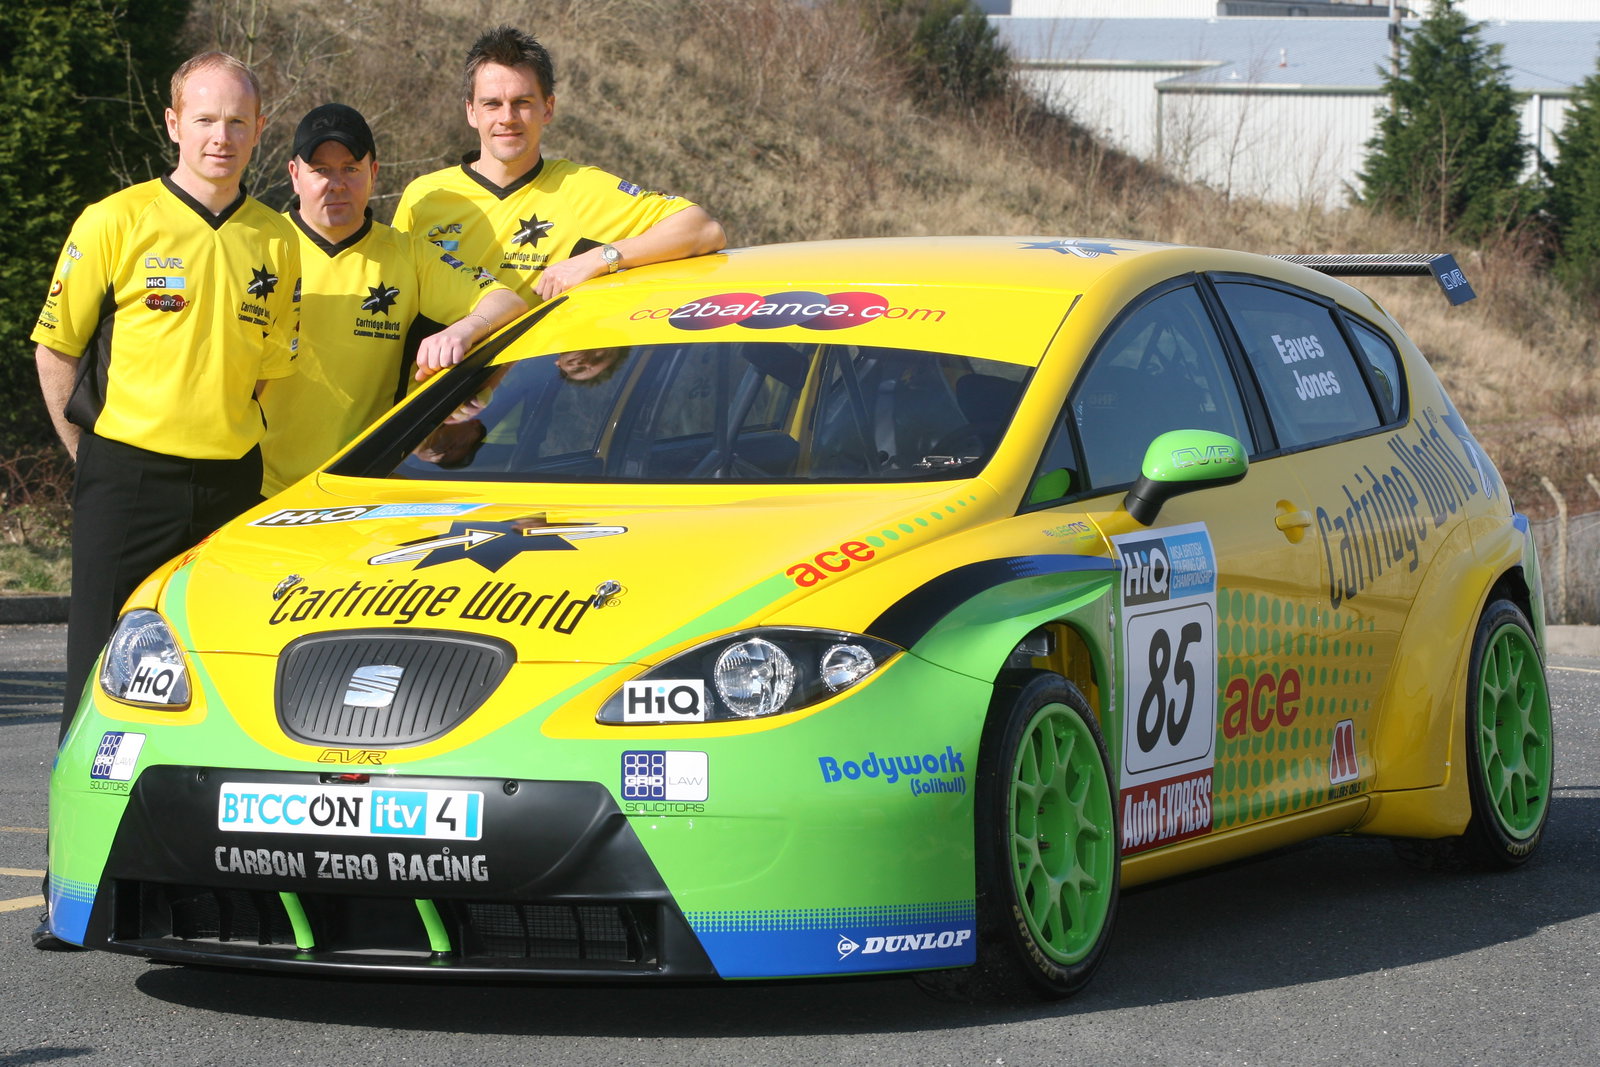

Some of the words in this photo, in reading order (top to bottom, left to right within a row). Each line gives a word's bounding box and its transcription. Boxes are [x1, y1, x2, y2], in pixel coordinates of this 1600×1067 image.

[428, 223, 462, 237] CVR
[145, 256, 184, 269] CVR
[147, 278, 166, 287] HiQ
[1440, 268, 1466, 290] CVR
[241, 301, 265, 318] Cartridge
[629, 299, 945, 322] co2balance.com
[356, 318, 384, 330] Cartridge
[1271, 333, 1325, 364] Eaves
[1294, 369, 1341, 401] Jones
[1171, 444, 1236, 469] CVR
[265, 507, 367, 525] HiQ
[1316, 464, 1427, 610] Cartridge
[1387, 410, 1478, 530] World
[786, 540, 876, 588] ace
[1123, 547, 1168, 597] HiQ
[269, 578, 460, 625] Cartridge
[460, 581, 594, 635] World
[130, 665, 174, 697] HiQ
[1136, 622, 1203, 753] 85
[628, 685, 701, 717] HiQ
[1222, 668, 1302, 739] ace
[317, 748, 387, 766] CVR
[818, 745, 965, 784] Bodywork
[625, 776, 664, 785] GRID
[668, 776, 703, 786] LAW
[911, 776, 967, 797] (Solihull)
[375, 795, 424, 830] itv
[435, 797, 457, 832] 4
[625, 802, 705, 813] SOLICITORS
[1122, 795, 1156, 850] Auto
[1158, 775, 1212, 832] EXPRESS
[215, 846, 305, 877] CARBON
[315, 851, 379, 880] ZERO
[388, 846, 489, 882] RACING
[861, 929, 972, 954] DUNLOP
